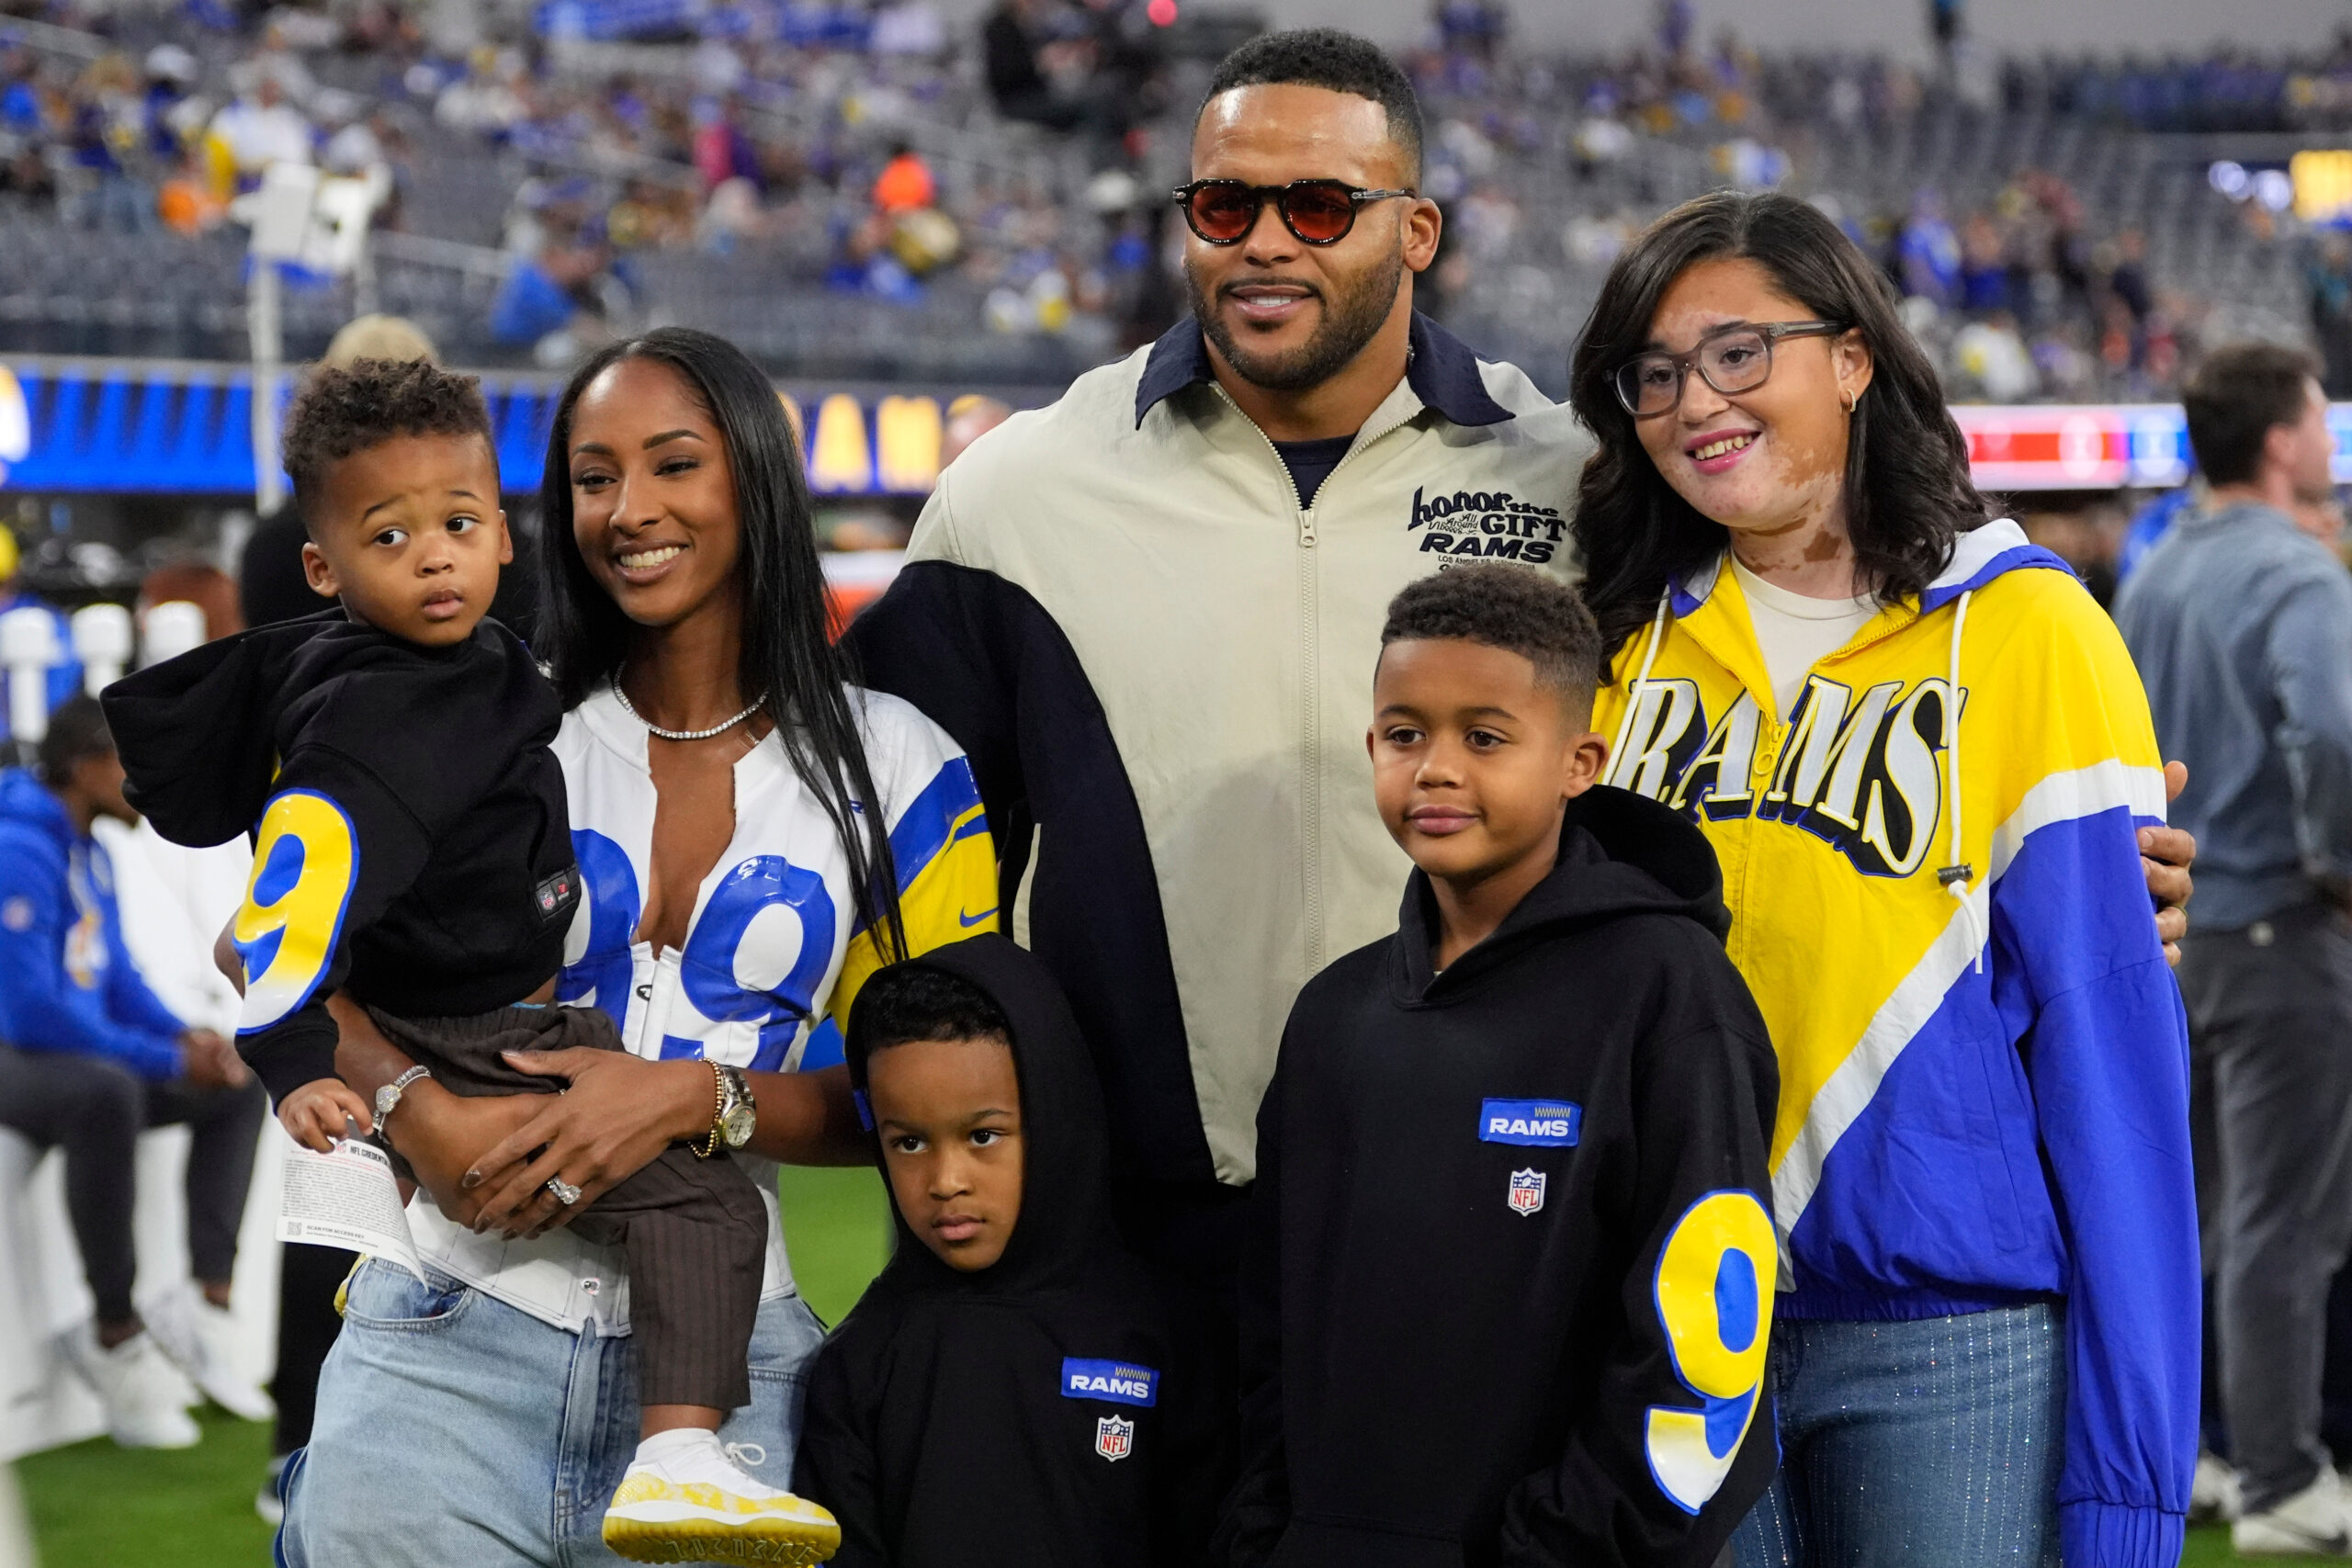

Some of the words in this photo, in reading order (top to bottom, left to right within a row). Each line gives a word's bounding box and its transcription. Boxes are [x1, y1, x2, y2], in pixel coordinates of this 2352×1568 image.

[1408, 485, 1513, 531] honor
[1506, 502, 1559, 517] the
[1459, 513, 1477, 523] All
[1444, 517, 1479, 529] Around
[1480, 513, 1566, 542] GIFT
[1419, 533, 1555, 564] RAMS
[1438, 555, 1453, 563] LOS
[1603, 673, 1969, 878] RAMS
[232, 787, 360, 1036] 9
[1489, 1118, 1569, 1137] RAMS
[350, 1145, 360, 1156] NFL
[1513, 1189, 1538, 1208] NFL
[1644, 1188, 1779, 1517] 9
[1070, 1374, 1149, 1399] RAMS
[1102, 1435, 1126, 1454] NFL
